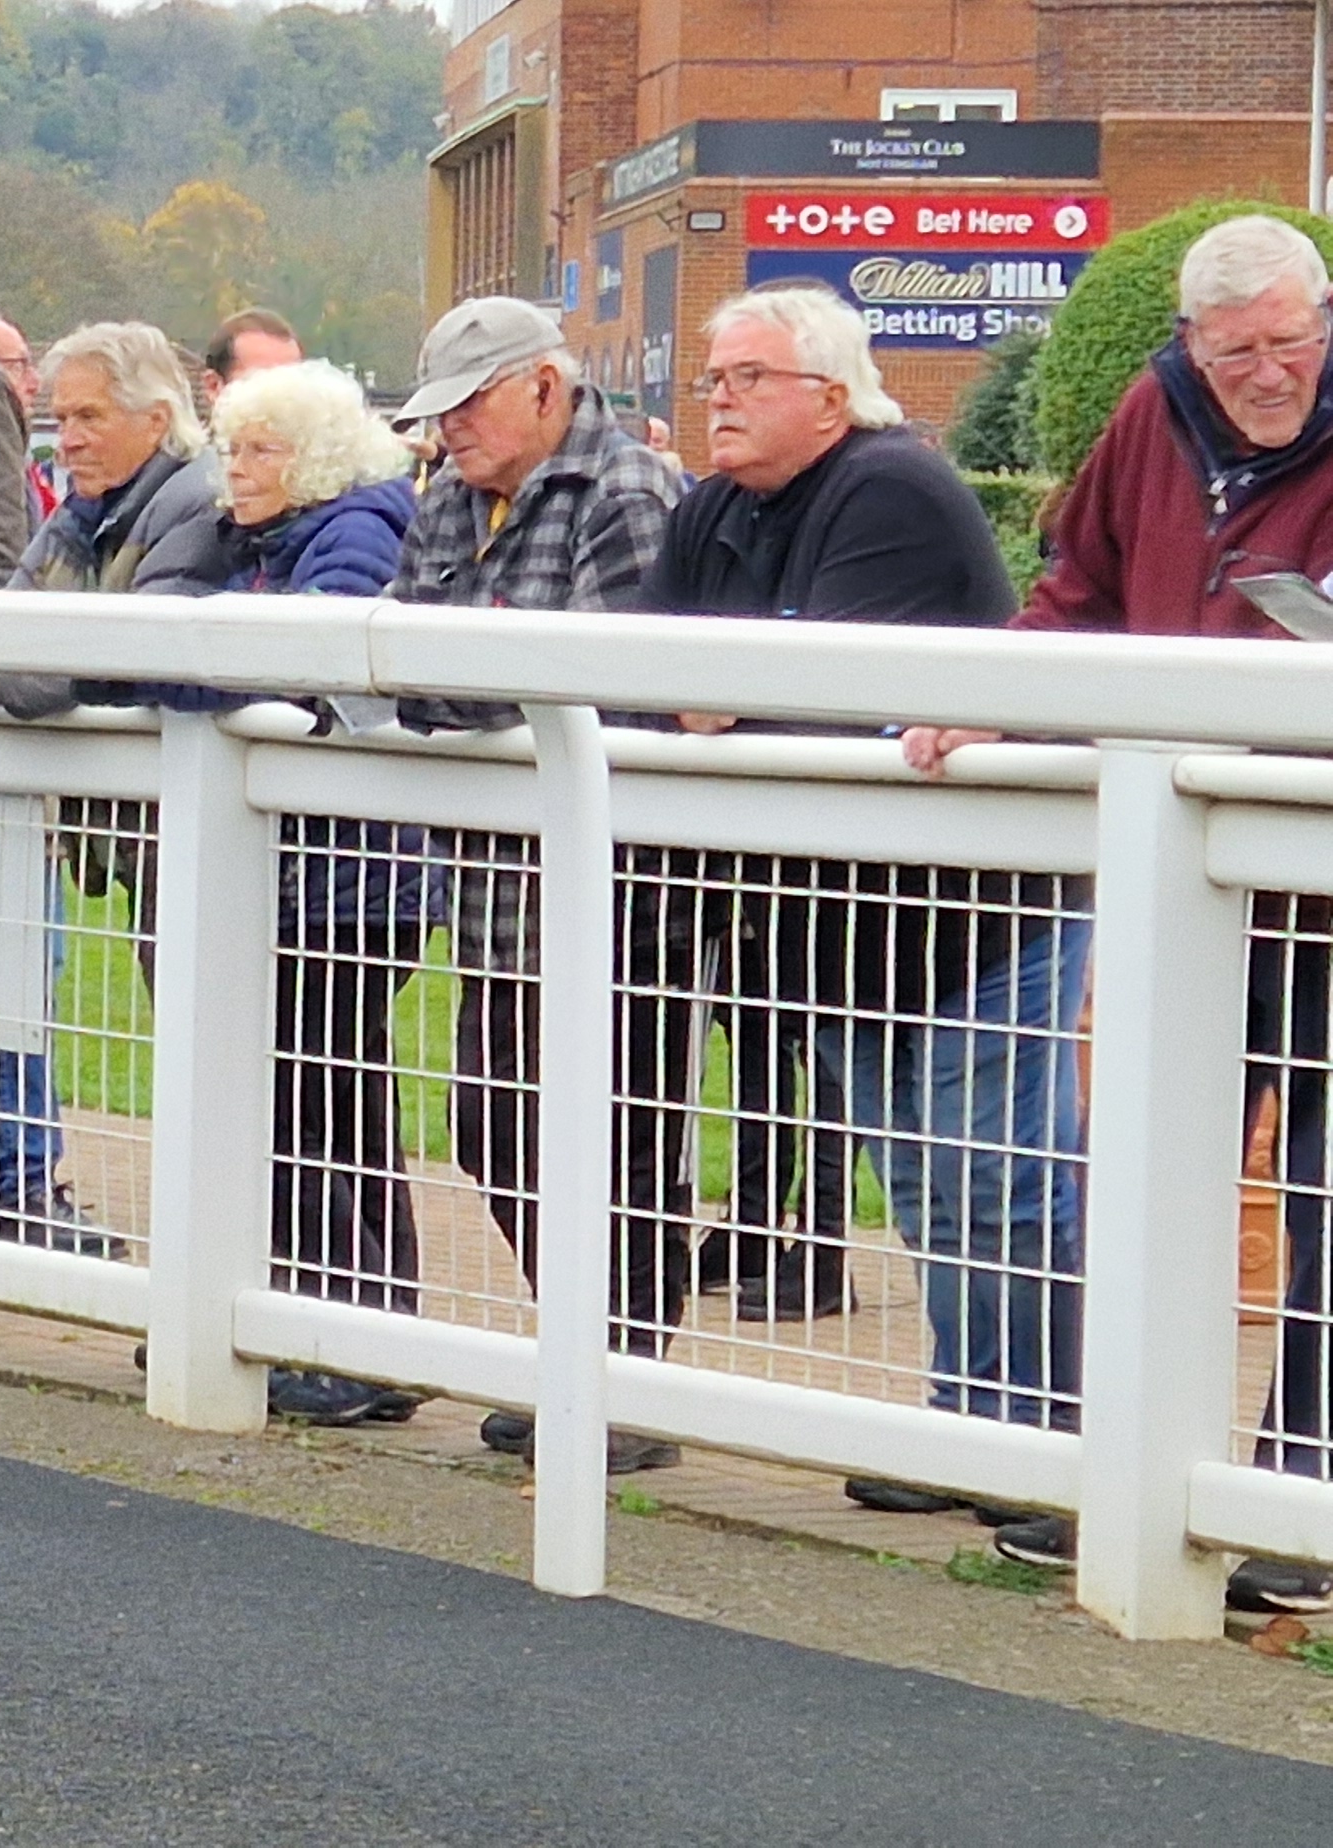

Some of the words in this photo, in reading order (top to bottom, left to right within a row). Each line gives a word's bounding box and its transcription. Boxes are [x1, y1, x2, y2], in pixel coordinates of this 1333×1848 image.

[917, 208, 962, 233] Bet
[968, 209, 1033, 234] Here
[849, 257, 991, 301] William
[990, 261, 1068, 298] HILL
[863, 308, 977, 341] Betting
